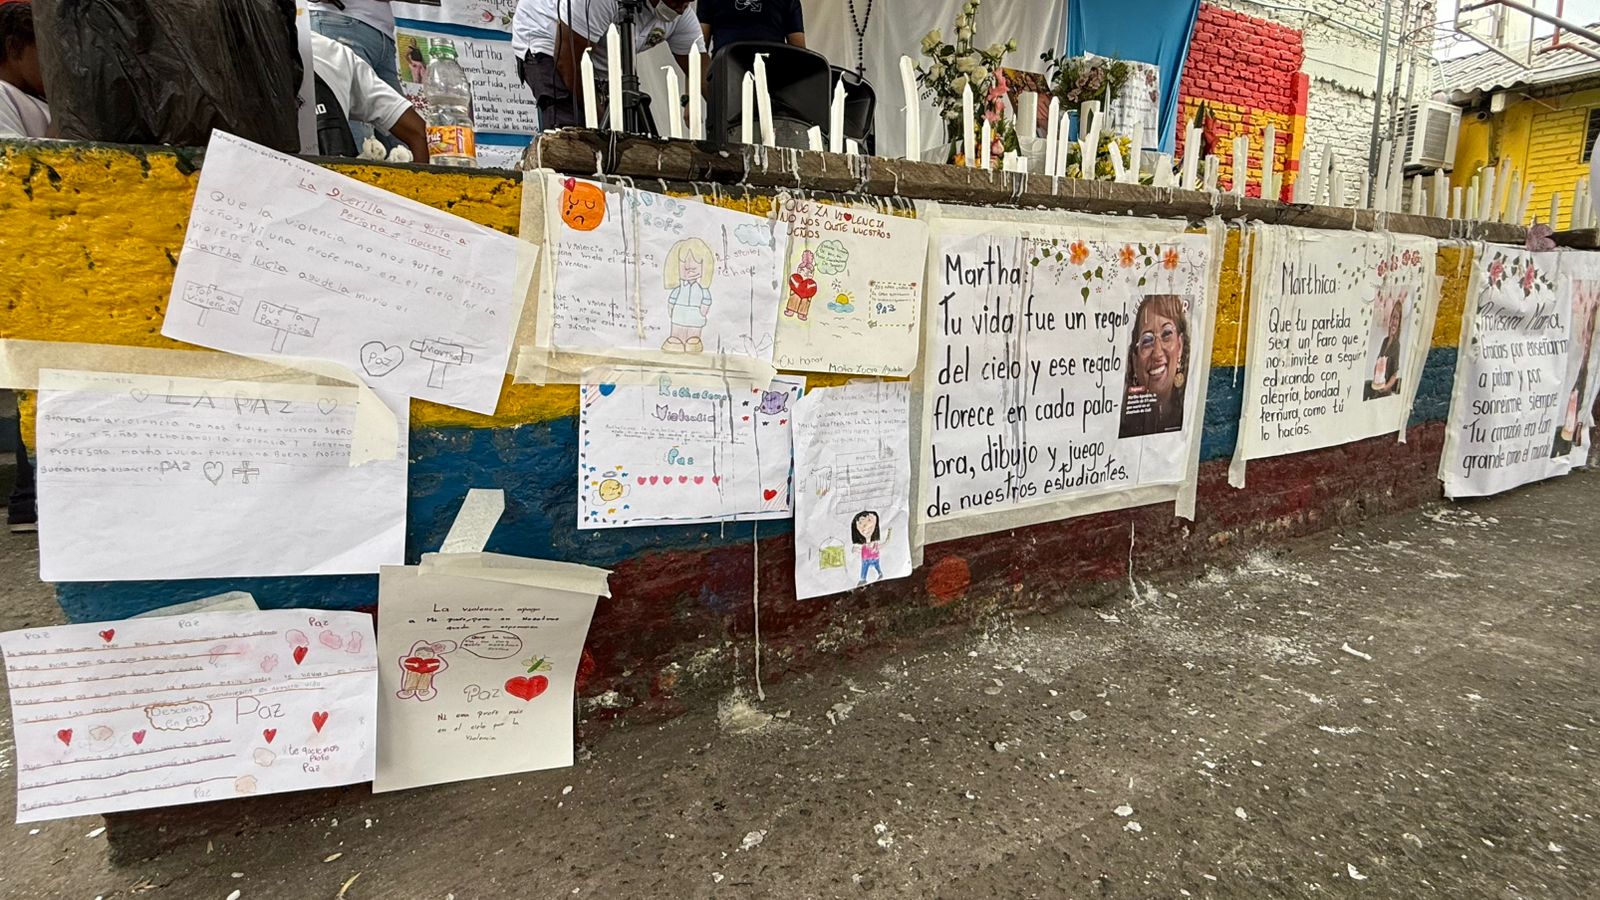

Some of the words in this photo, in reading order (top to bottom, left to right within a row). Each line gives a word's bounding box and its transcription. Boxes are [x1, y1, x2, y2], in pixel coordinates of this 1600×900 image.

[464, 41, 503, 60] Martha
[945, 245, 1029, 288] Martha:
[1281, 261, 1341, 296] Marthica:
[938, 291, 962, 336] Tu
[972, 295, 1014, 335] vida
[1024, 294, 1056, 332] fue
[1064, 311, 1087, 331] un
[1094, 301, 1130, 343] regalo
[1268, 306, 1292, 334] Que
[1295, 308, 1307, 332] tu
[1311, 307, 1351, 342] partida
[1298, 337, 1310, 350] un
[1316, 331, 1338, 348] faro
[1341, 333, 1360, 353] que
[1526, 337, 1568, 357] enseñarm
[938, 344, 970, 385] del
[981, 341, 1021, 381] cielo
[1030, 359, 1041, 396] y
[1049, 356, 1076, 378] ese
[1082, 344, 1122, 389] regalo
[1290, 348, 1319, 367] invite
[1324, 353, 1333, 364] a
[1337, 350, 1362, 370] seguir
[1320, 370, 1338, 382] con
[1303, 379, 1341, 402] bondad
[933, 393, 996, 431] florece
[1006, 403, 1028, 424] en
[1035, 387, 1075, 422] cada
[1083, 385, 1120, 434] pala-
[1303, 405, 1327, 418] como
[1260, 425, 1270, 441] lo
[931, 444, 977, 480] bra,
[981, 433, 1038, 480] dibujo
[1047, 445, 1058, 473] y
[1065, 439, 1105, 473] juego
[1462, 444, 1505, 479] grande
[926, 485, 951, 519] de
[959, 470, 1038, 510] nuestros
[1043, 453, 1130, 495] estudiantes.
[433, 603, 450, 613] La
[308, 616, 330, 628] Paz
[464, 683, 500, 703] Paz
[236, 695, 287, 725] Paz
